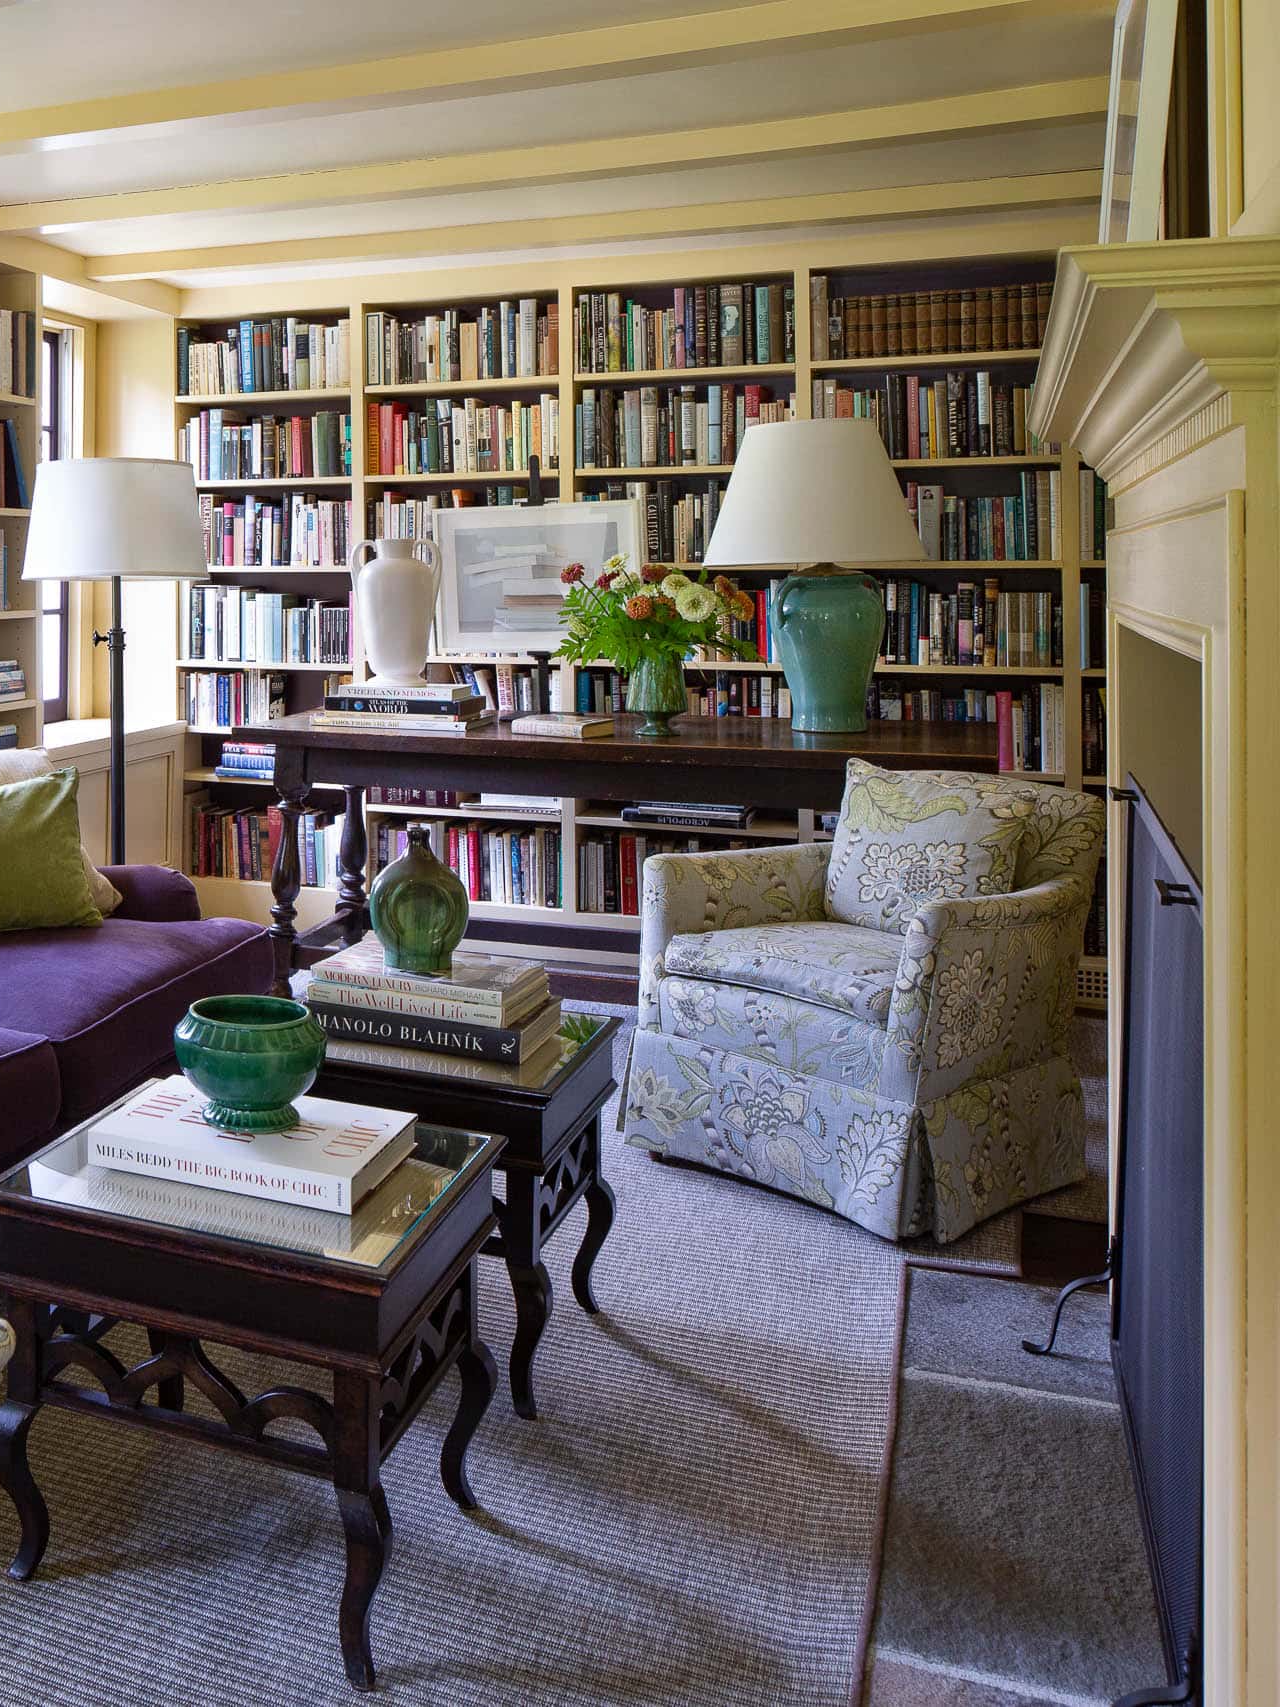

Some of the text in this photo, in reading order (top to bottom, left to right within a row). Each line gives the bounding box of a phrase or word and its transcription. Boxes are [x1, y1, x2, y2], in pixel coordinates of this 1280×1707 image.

[647, 505, 658, 520] CALL
[647, 530, 658, 550] SLEEP
[368, 704, 409, 714] WORLD
[657, 815, 711, 827] ACROPOLIS
[324, 970, 370, 986] MODERN
[370, 977, 412, 992] LUXURY
[337, 988, 363, 1004] The
[363, 991, 437, 1017] Well-Lived
[439, 1003, 468, 1019] Life
[315, 1013, 484, 1052] MANOLO BLAHNÍK
[96, 1143, 135, 1160] MILES
[135, 1153, 173, 1169] REDD
[173, 1158, 203, 1174] THE
[203, 1164, 229, 1179] BIG
[230, 1170, 269, 1188] BOOK
[269, 1176, 290, 1191] OF
